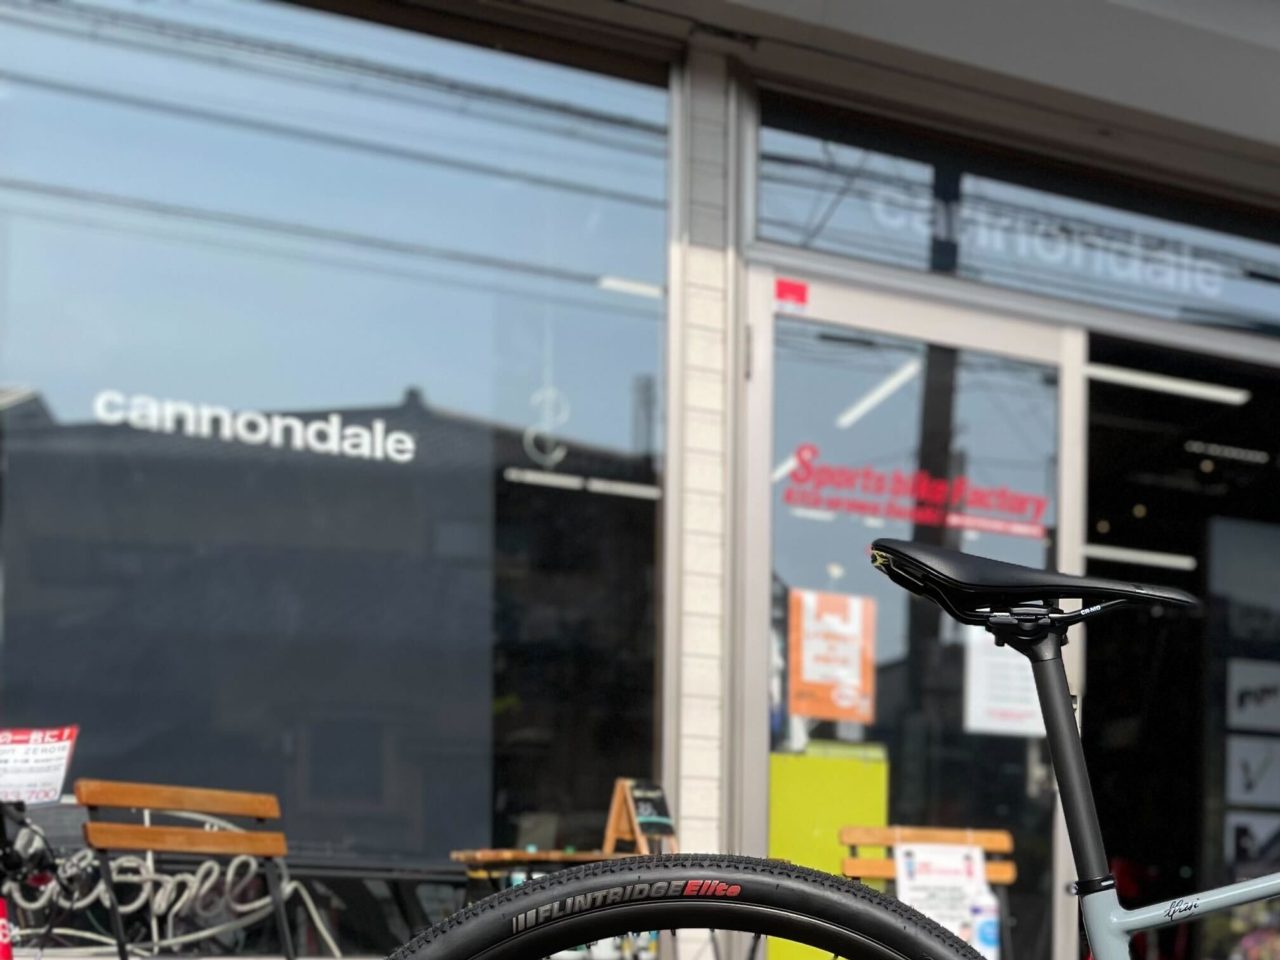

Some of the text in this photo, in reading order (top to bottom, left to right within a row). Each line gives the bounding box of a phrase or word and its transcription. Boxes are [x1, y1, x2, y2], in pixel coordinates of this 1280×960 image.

[92, 389, 417, 463] cannondale
[537, 879, 742, 924] FLINTRIDGE Elite
